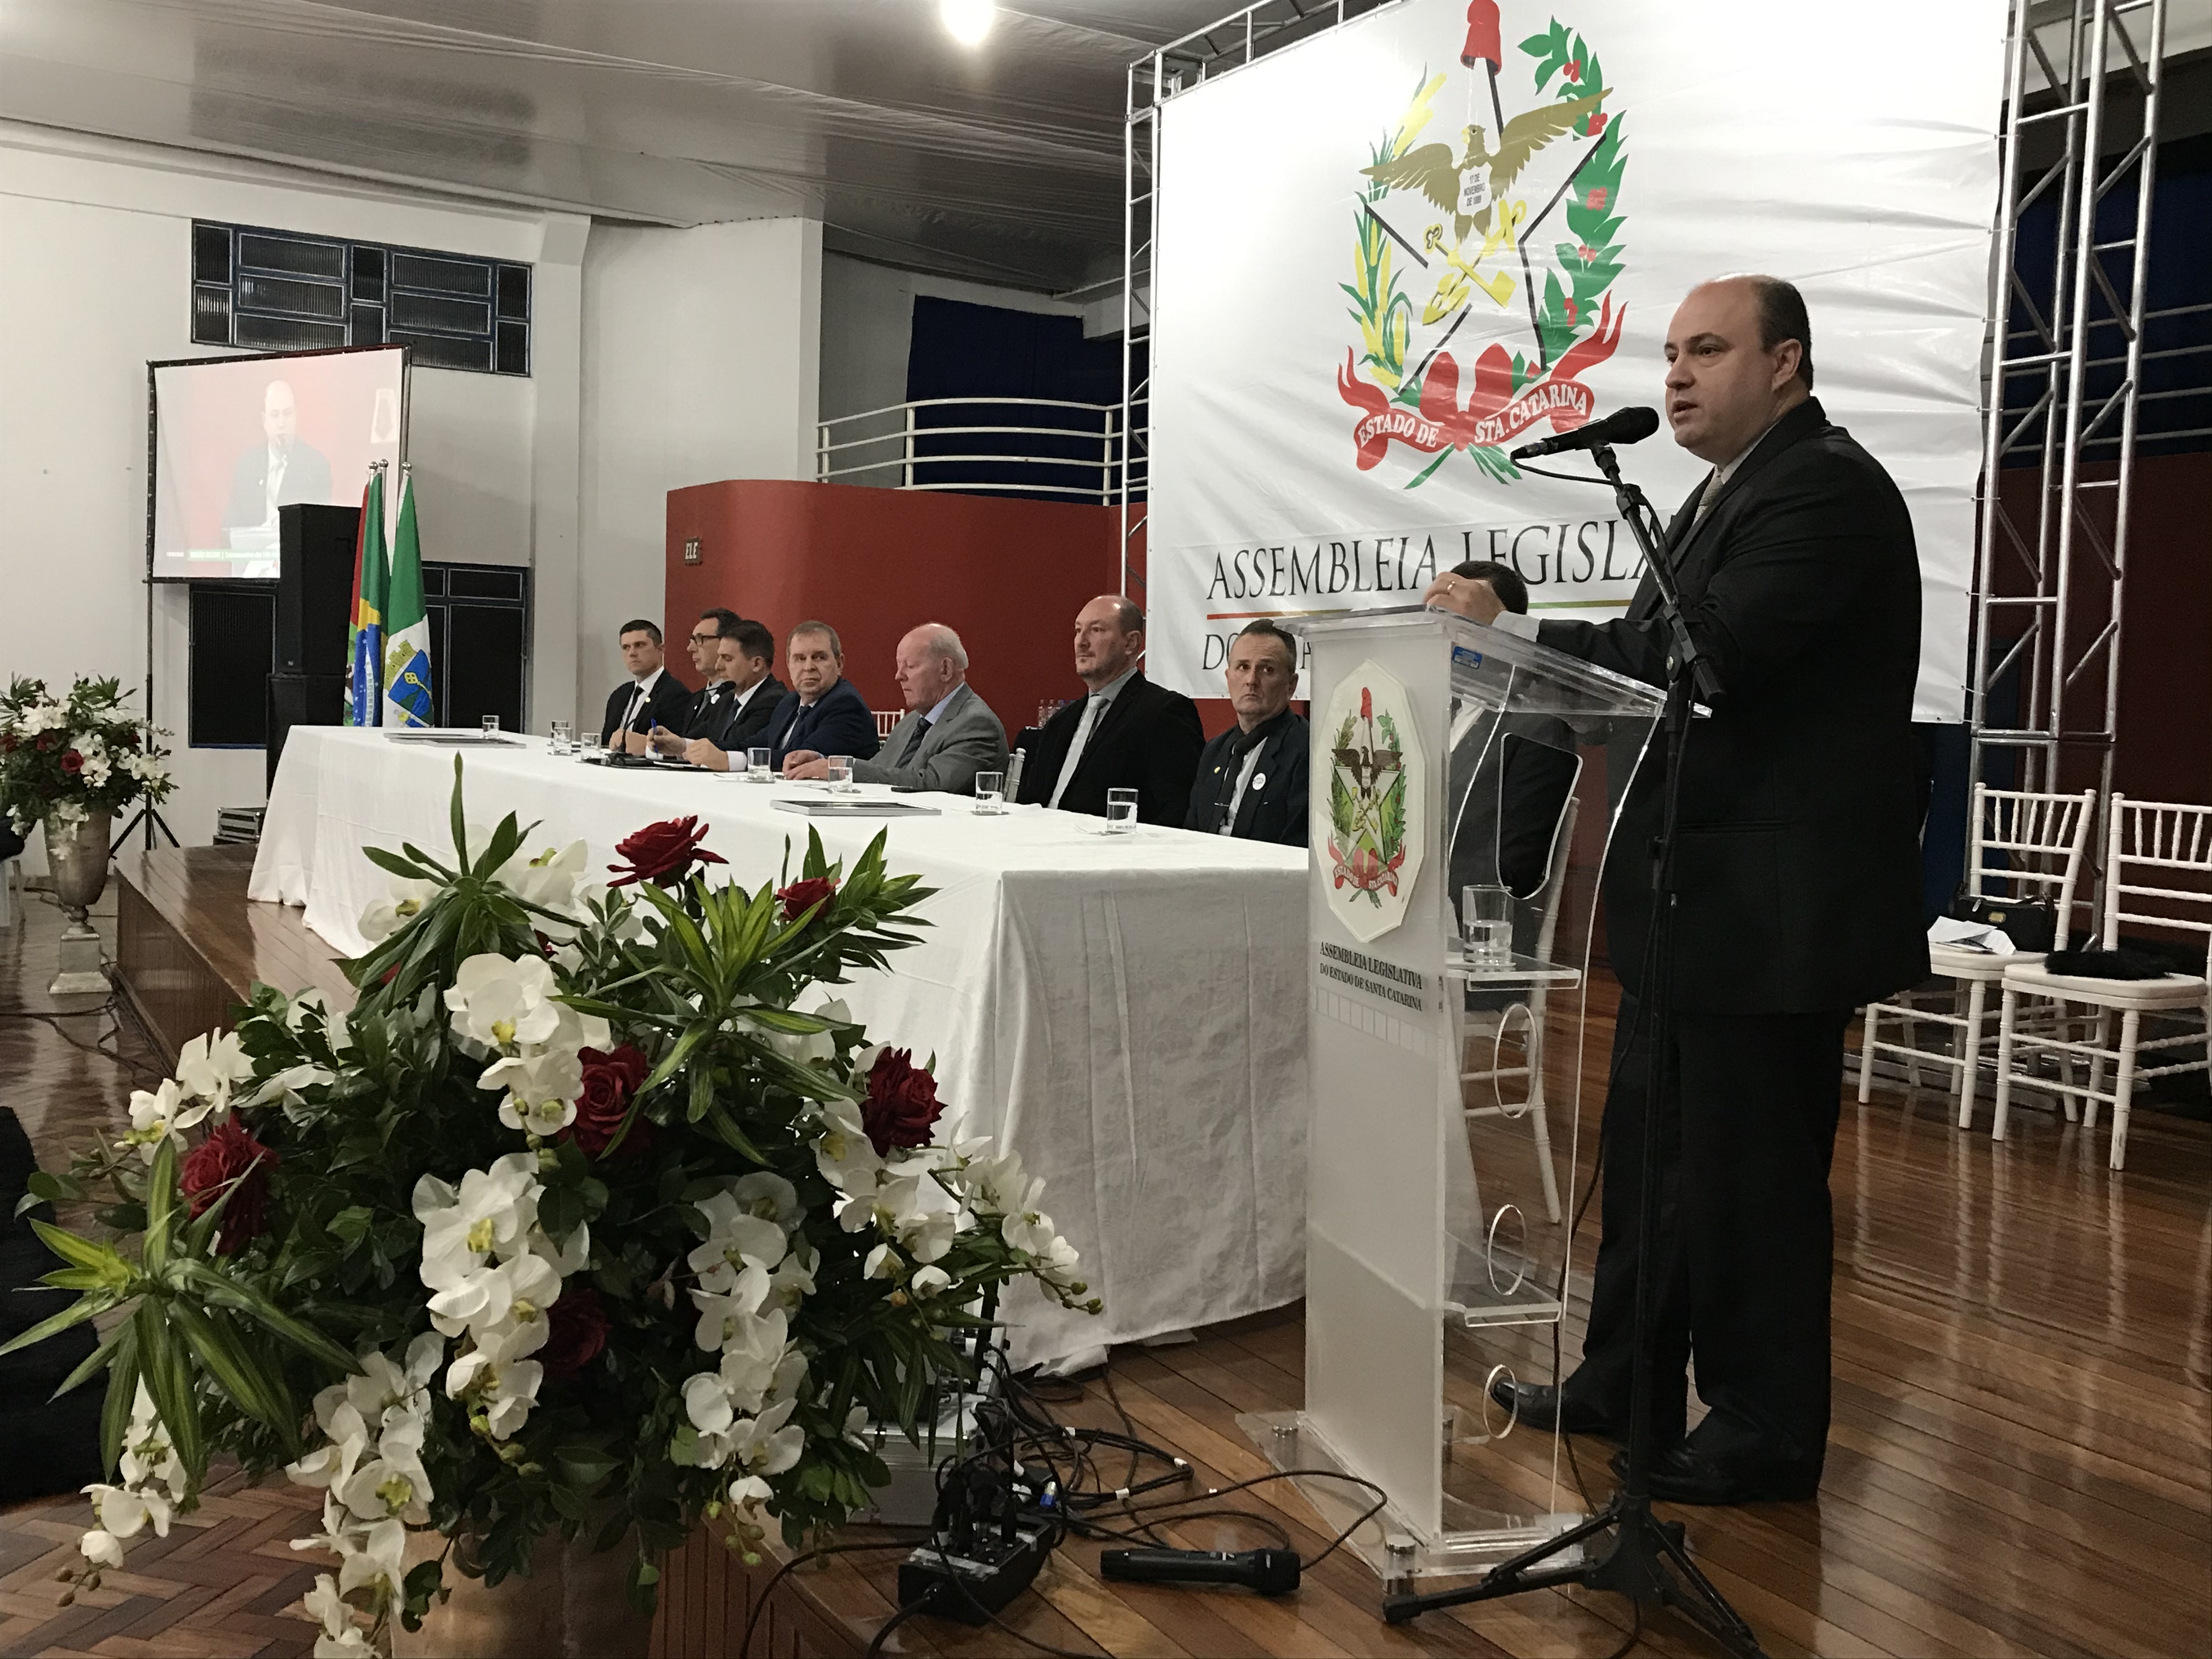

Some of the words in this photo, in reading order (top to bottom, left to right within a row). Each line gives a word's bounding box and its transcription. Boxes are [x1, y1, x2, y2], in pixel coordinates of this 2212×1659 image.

[1466, 197, 1472, 207] DE
[1475, 173, 1480, 183] DE
[1358, 413, 1414, 448] ESTADO
[1417, 422, 1439, 448] DE
[1475, 417, 1510, 443] STA.
[1509, 383, 1587, 430] CATARINA
[1206, 534, 1436, 600] ASSEMBLEIA
[1320, 941, 1367, 970] ASSEMBLEIA
[1368, 957, 1422, 990] LEGISLATIVA
[1320, 963, 1329, 975] DO
[1329, 966, 1353, 986] ESTADO
[1355, 975, 1364, 989] DE
[1365, 979, 1386, 998] SANTA
[1387, 988, 1422, 1012] CATARINA
